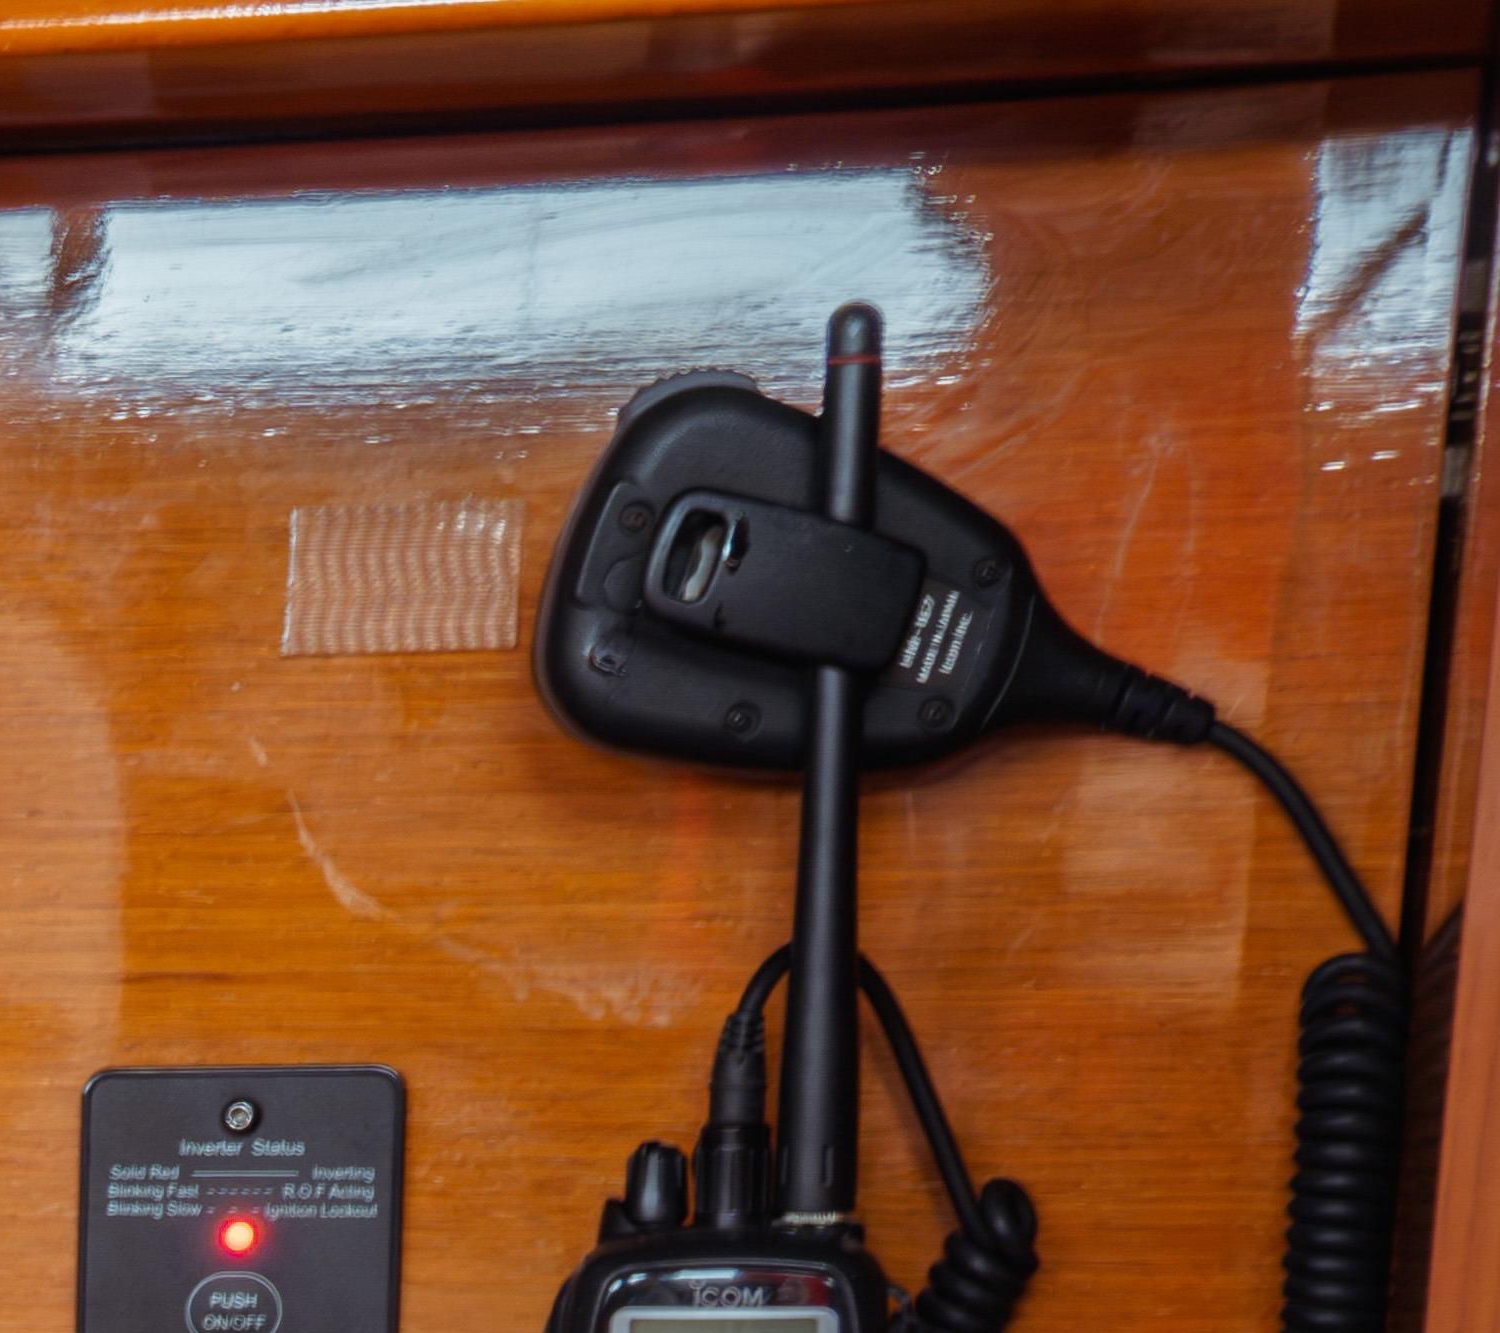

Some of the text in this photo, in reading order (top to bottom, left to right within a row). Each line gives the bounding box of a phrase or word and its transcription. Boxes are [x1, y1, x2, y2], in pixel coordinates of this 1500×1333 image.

[178, 1139, 305, 1156] Inverter Status
[109, 1164, 376, 1183] Solid Red Inverting
[107, 1184, 164, 1201] Blinking
[168, 1184, 199, 1198] Fast
[107, 1201, 163, 1219] Blinking
[167, 1202, 202, 1217] Slow
[209, 1292, 258, 1310] PUSH
[203, 1314, 267, 1331] ON/OFF
